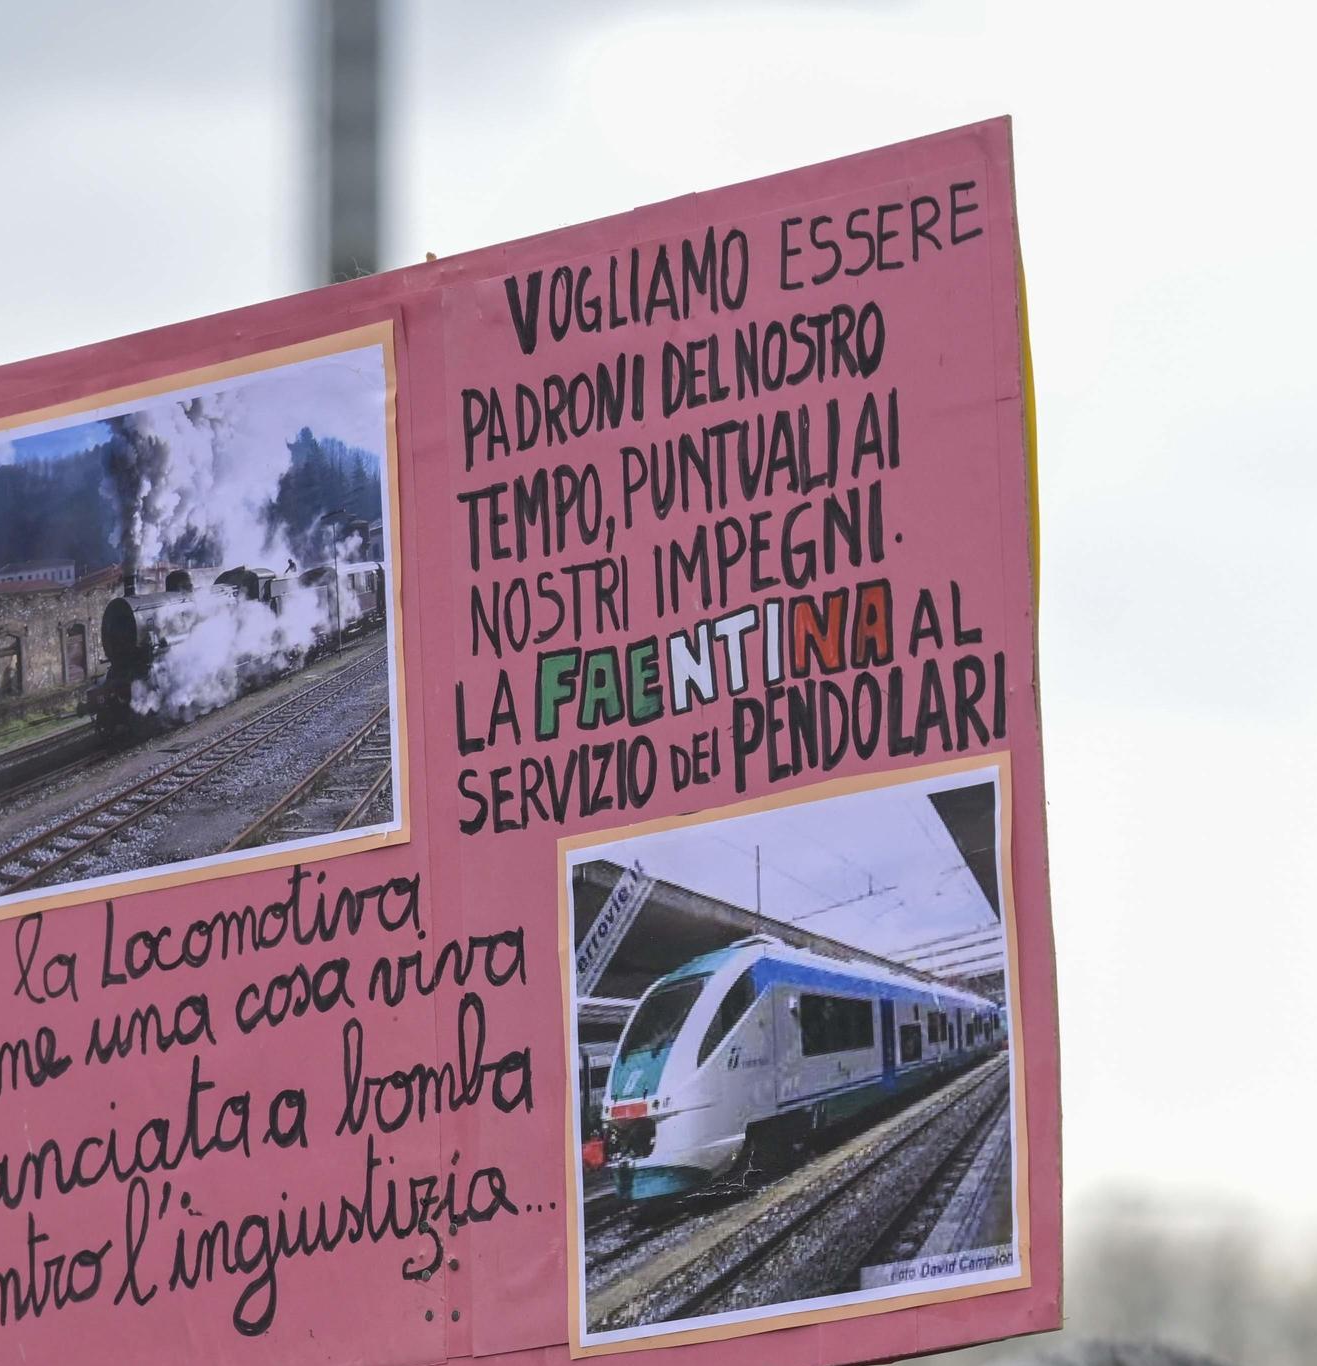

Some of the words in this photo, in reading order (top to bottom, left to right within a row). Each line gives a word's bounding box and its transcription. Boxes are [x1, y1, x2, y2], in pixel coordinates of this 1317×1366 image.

[504, 226, 749, 355] VOGLIAMO
[780, 180, 983, 291] ESSERE
[462, 352, 645, 472] PADRONI
[662, 334, 730, 418] DEL
[735, 301, 885, 399] NOSTRO
[457, 462, 616, 571] TEMPO,
[621, 398, 839, 529] PUNTUALI
[851, 387, 900, 478] AI
[470, 555, 629, 658] NOSTRI
[654, 480, 903, 618] IMPEGNI.
[456, 669, 522, 756] LA
[535, 578, 893, 741] FAENTINA
[908, 580, 983, 657] AL
[457, 735, 658, 835] SERVIZIO
[732, 652, 1007, 793] PENDOLARI
[14, 912, 78, 1004] la
[102, 864, 422, 988] Locomotiva
[86, 993, 217, 1065] una
[235, 957, 355, 1034] cosa
[369, 930, 527, 1008] viva
[262, 1087, 308, 1148] a
[335, 992, 534, 1136] bomba
